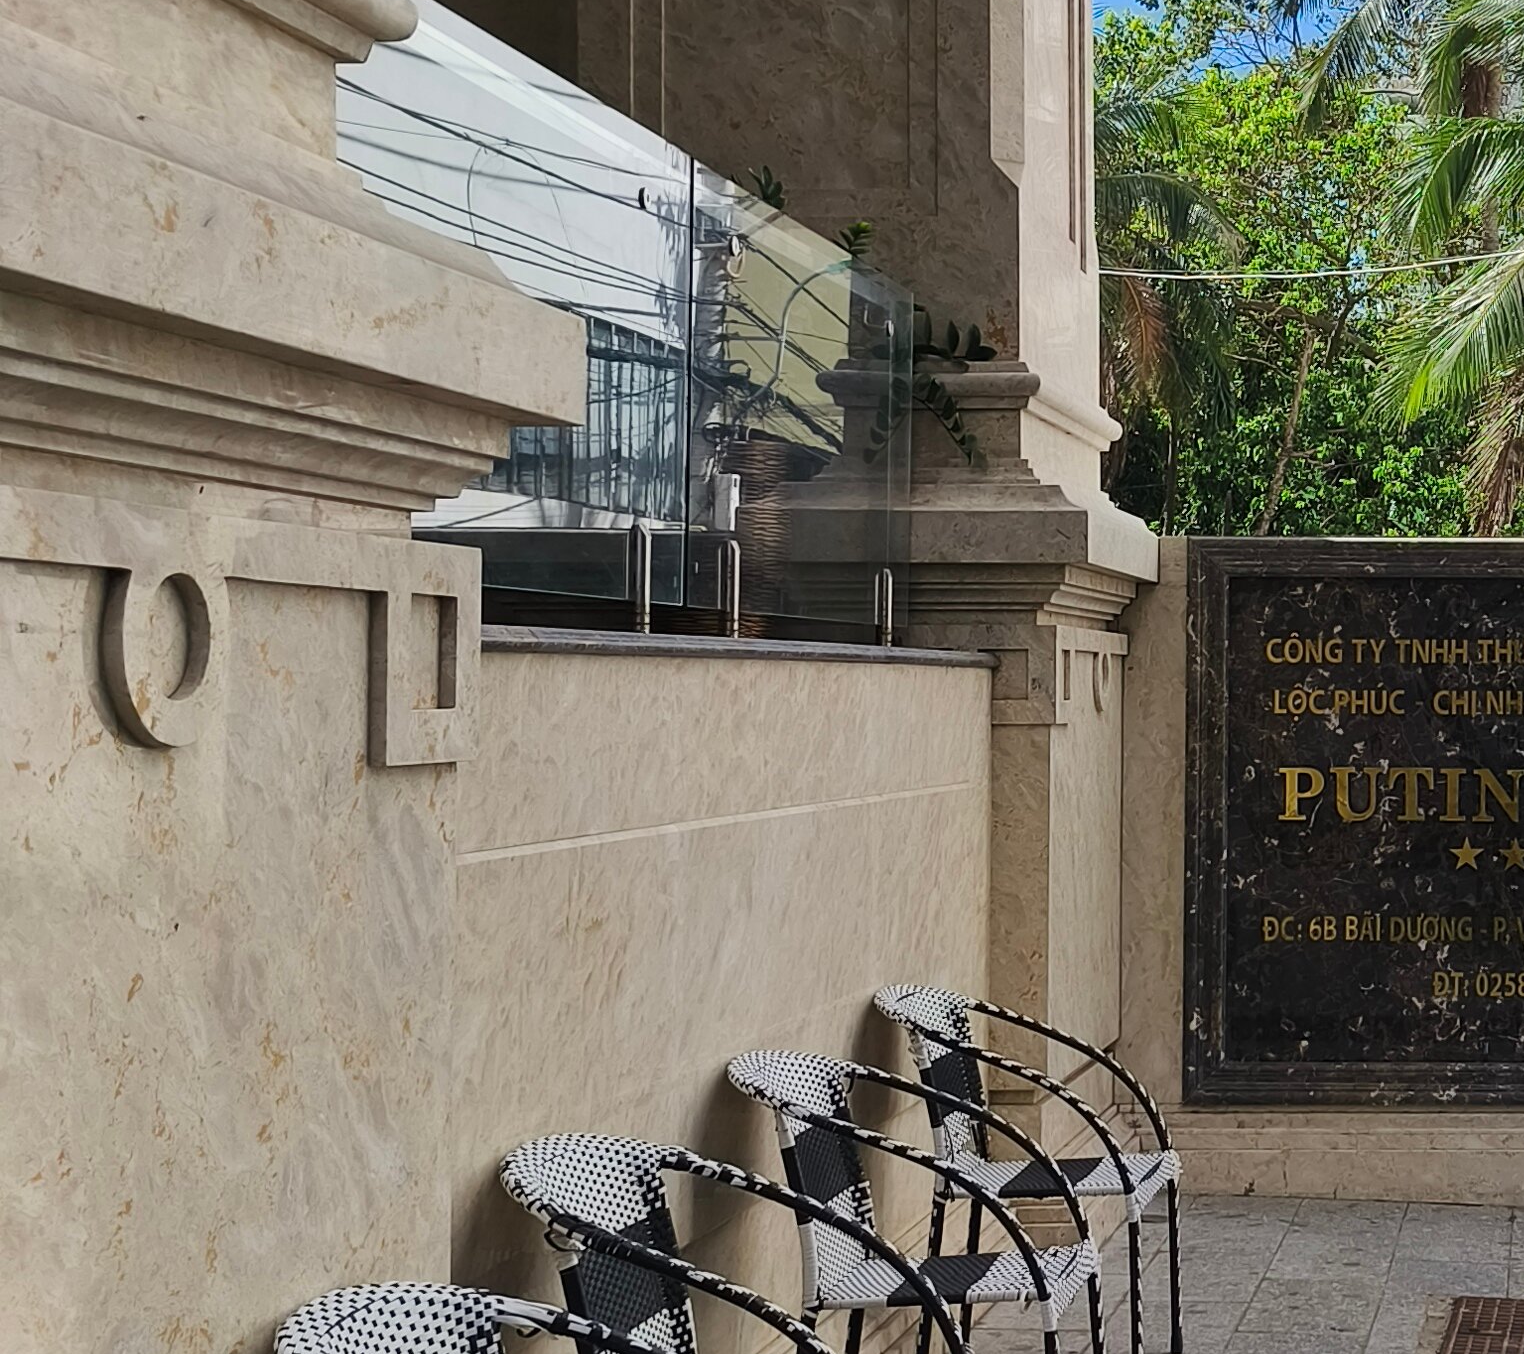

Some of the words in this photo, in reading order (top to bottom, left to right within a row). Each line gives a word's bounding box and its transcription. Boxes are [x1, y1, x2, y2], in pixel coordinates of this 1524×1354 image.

[1266, 632, 1344, 664] CÔNG
[1352, 638, 1386, 664] TY
[1396, 638, 1468, 664] TNHH
[1273, 683, 1325, 722] LỘC
[1333, 681, 1406, 715] PHÚC
[1432, 689, 1477, 717] CHI
[1308, 916, 1337, 942] 6B
[1389, 912, 1473, 943] DƯƠNG
